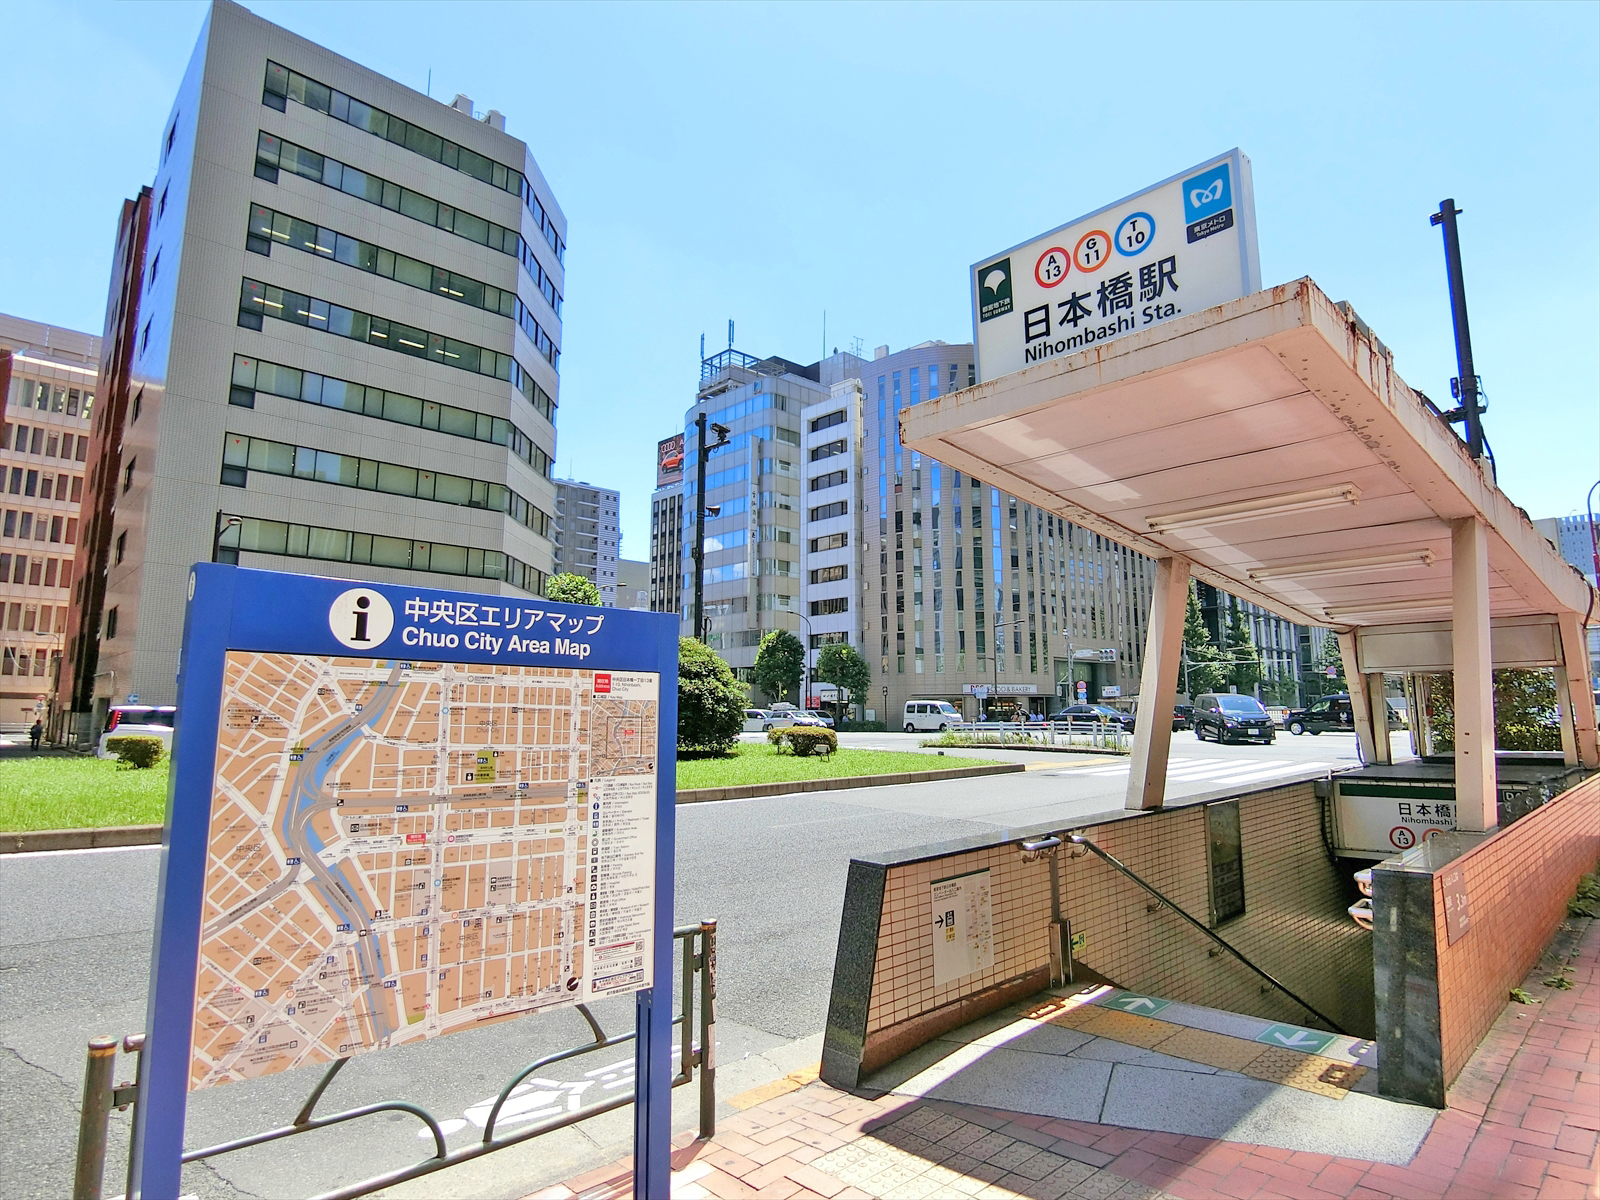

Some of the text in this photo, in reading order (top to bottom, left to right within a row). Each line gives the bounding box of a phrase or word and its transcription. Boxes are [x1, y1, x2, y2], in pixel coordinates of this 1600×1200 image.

[1130, 219, 1138, 232] T
[1194, 215, 1226, 233] 東京メトロ
[1086, 237, 1097, 250] G
[1126, 231, 1145, 248] 10
[1047, 254, 1057, 267] A
[1085, 250, 1100, 265] 11
[1045, 266, 1062, 281] 13
[982, 297, 1011, 313] 都営地下鉄
[1023, 254, 1179, 345] 日本橋駅
[1024, 302, 1182, 364] Nihombashi Sta.
[404, 597, 605, 635] 中央区エリアマップ
[402, 626, 592, 660] Chuo City Area Map
[1398, 802, 1457, 818] 日本橋
[1401, 816, 1453, 826] Nihombashi
[236, 843, 262, 852] 中央区
[1397, 836, 1409, 845] 13
[231, 852, 265, 861] Chuo City
[470, 940, 480, 948] City
